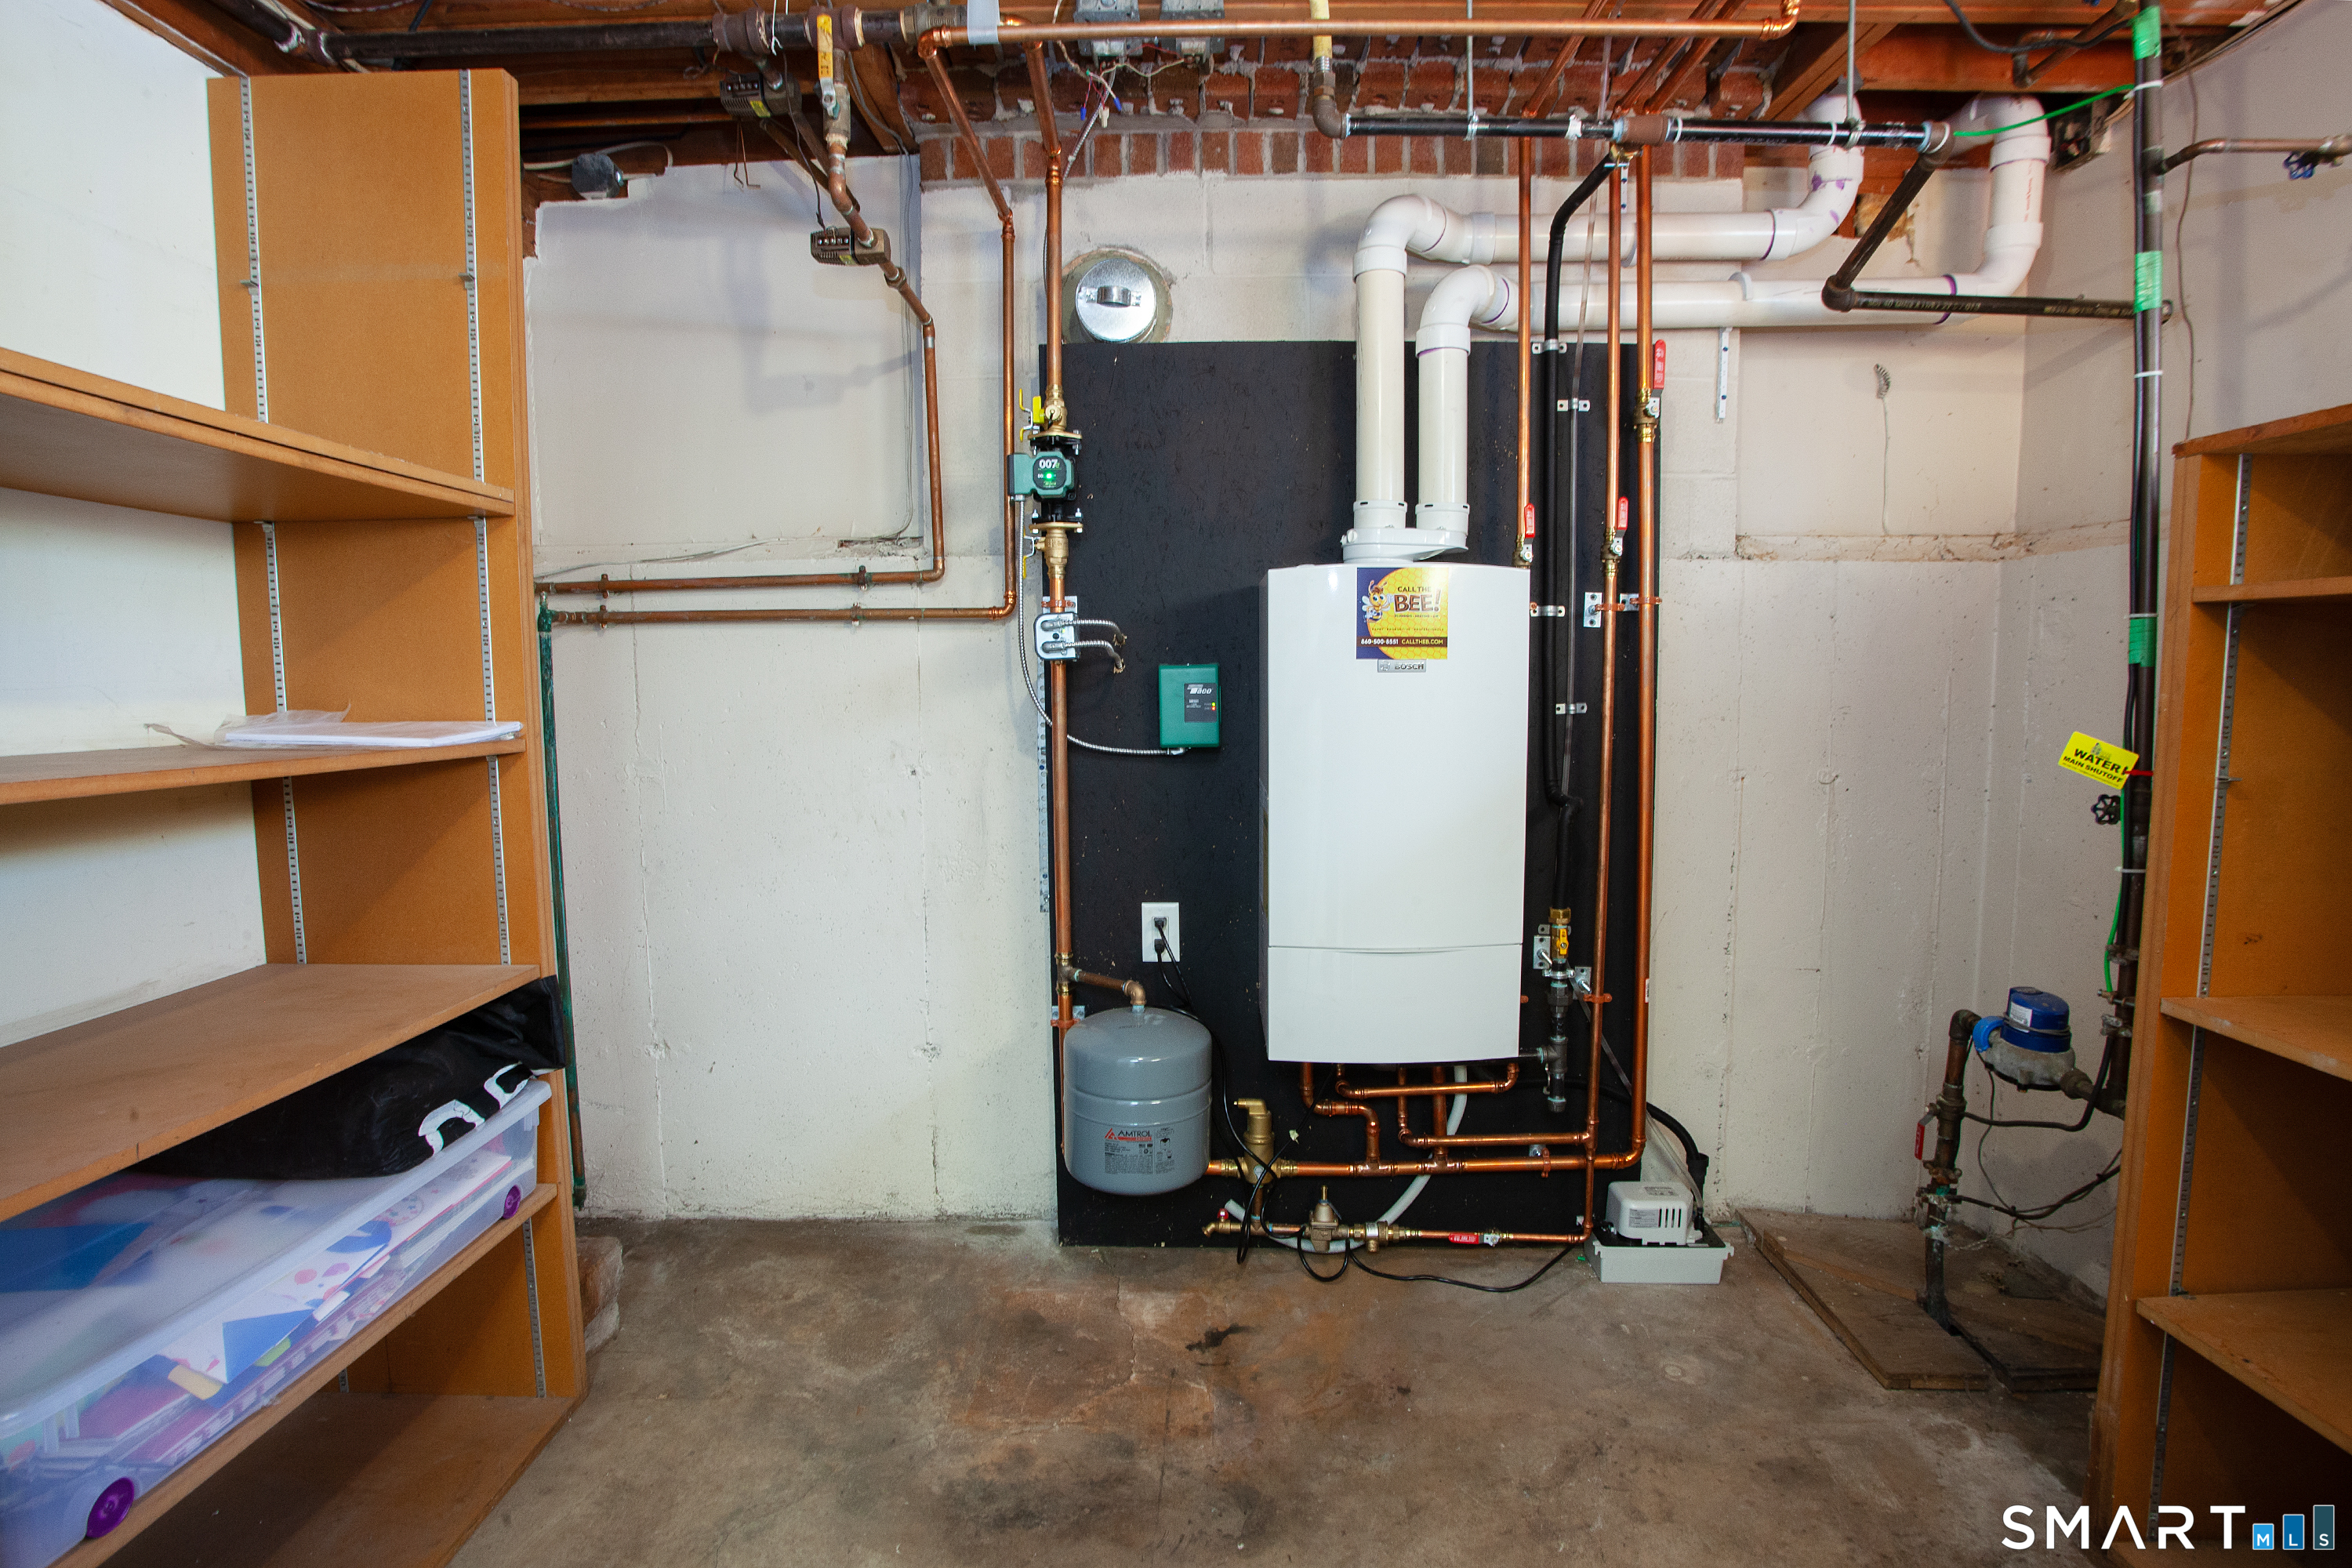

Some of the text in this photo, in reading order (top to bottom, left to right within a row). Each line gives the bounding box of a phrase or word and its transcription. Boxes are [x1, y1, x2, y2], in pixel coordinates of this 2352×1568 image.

[1394, 589, 1442, 613] BEE!
[1394, 661, 1425, 670] BOSCH
[2063, 756, 2123, 782] MAIN SHUTOFF
[1118, 1129, 1152, 1138] AMTROL
